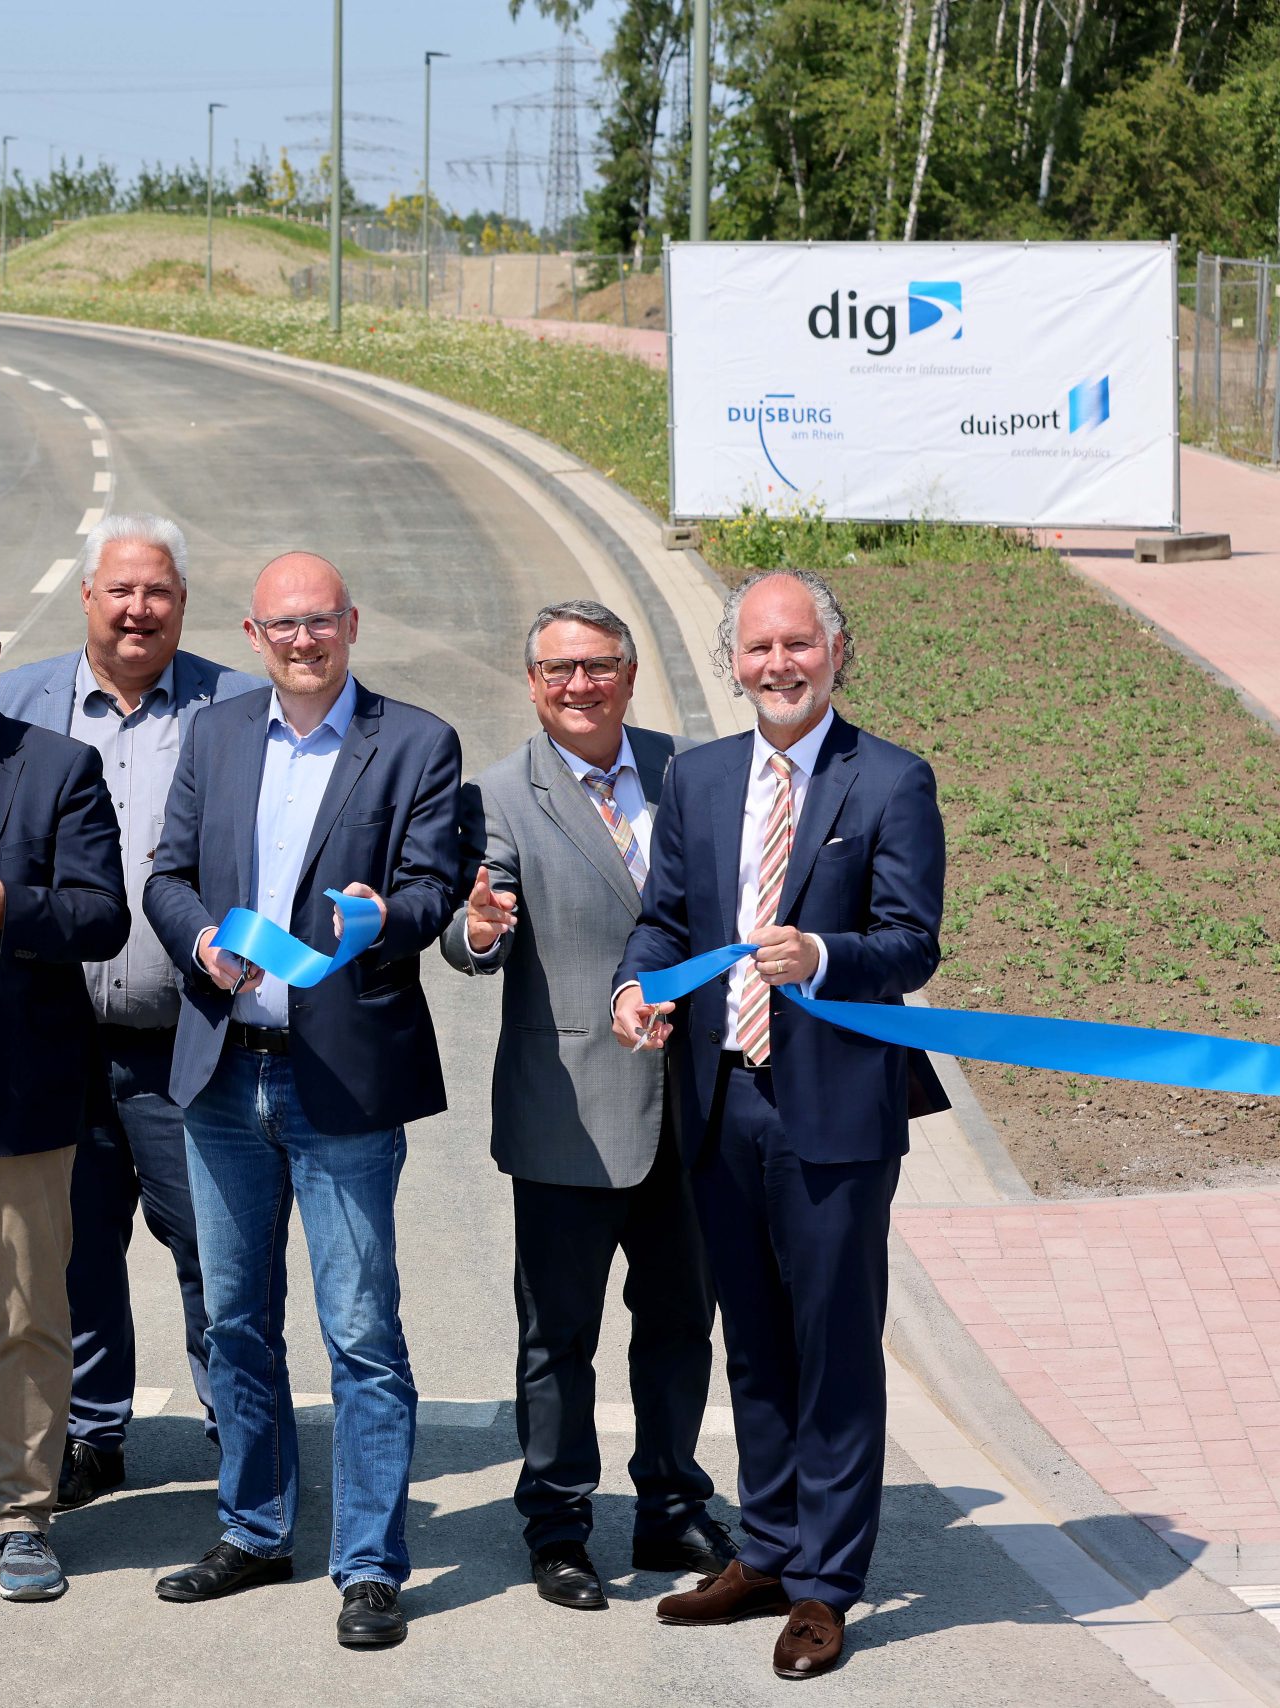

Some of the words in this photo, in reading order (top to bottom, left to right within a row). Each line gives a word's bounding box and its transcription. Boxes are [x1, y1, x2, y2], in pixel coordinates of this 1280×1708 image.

[808, 289, 897, 356] dig
[849, 363, 903, 375] excellence
[905, 363, 916, 375] in
[918, 363, 993, 376] infrastructure
[960, 409, 1061, 436] duisport
[791, 431, 809, 440] am
[812, 429, 844, 440] Rhein
[1010, 447, 1058, 457] excellence
[1061, 447, 1071, 457] in
[1072, 447, 1111, 459] logistics
